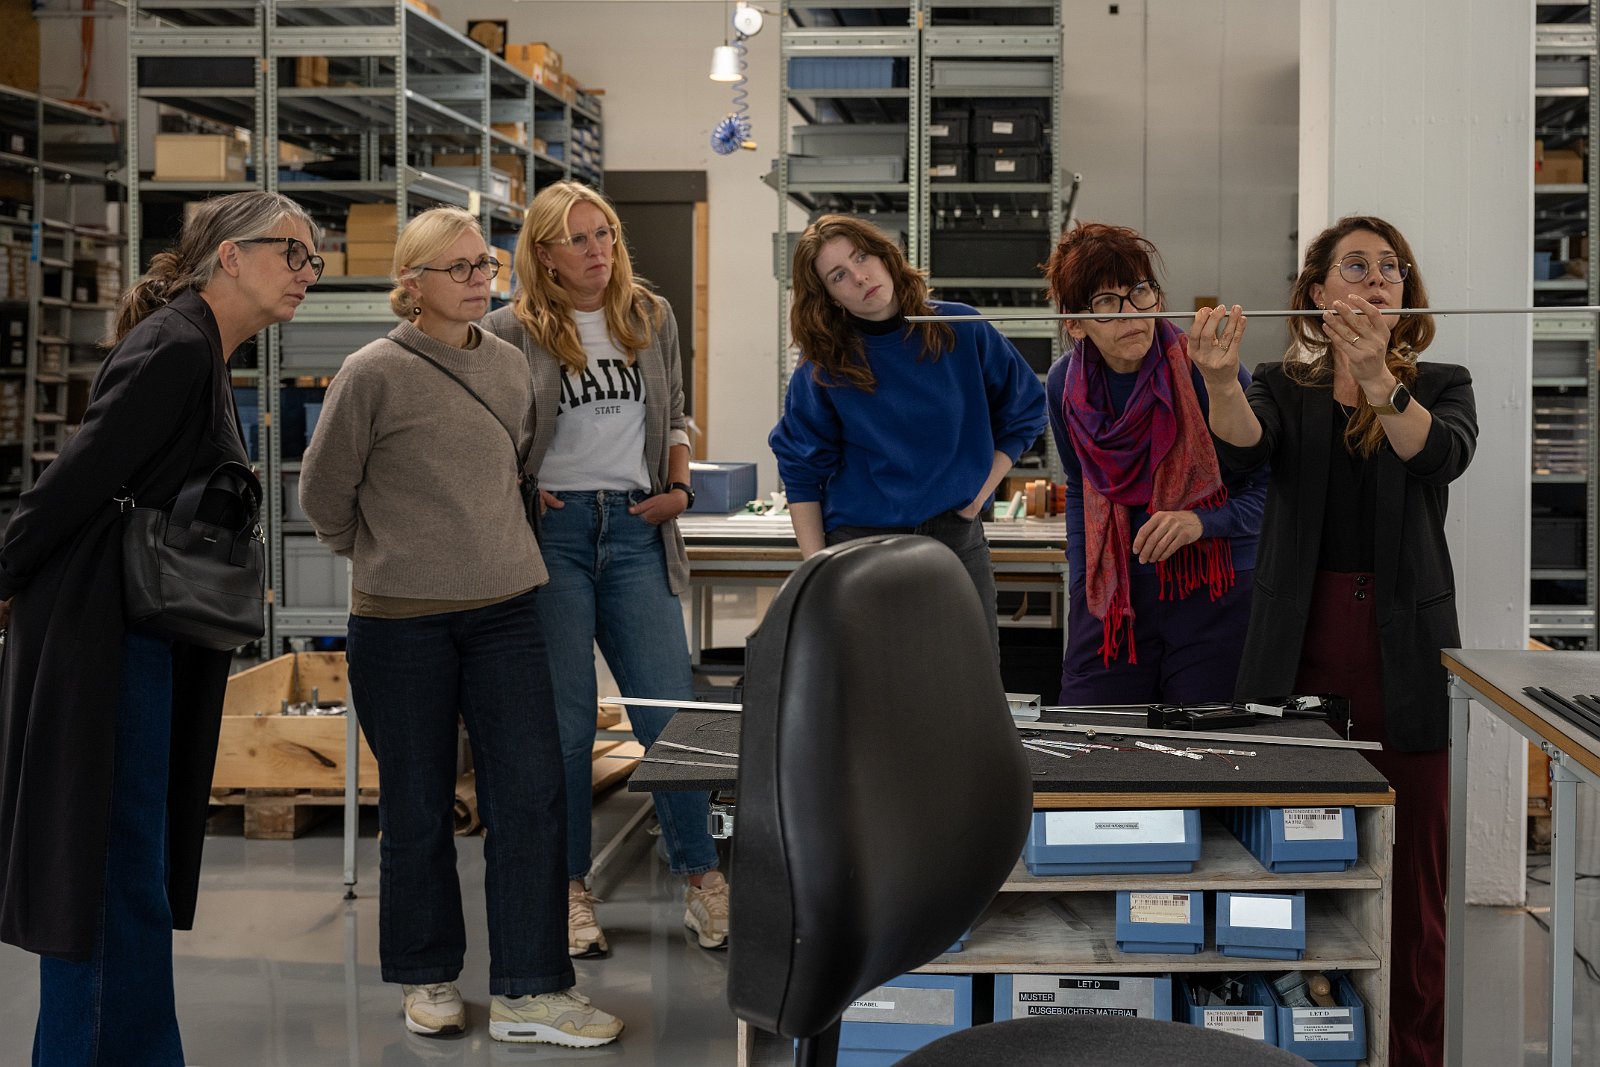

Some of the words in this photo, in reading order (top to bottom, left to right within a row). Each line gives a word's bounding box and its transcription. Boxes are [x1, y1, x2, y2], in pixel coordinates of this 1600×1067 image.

[557, 359, 646, 416] MAIN
[595, 406, 621, 415] STATE
[1077, 980, 1093, 988] LET
[1095, 981, 1101, 989] D
[1020, 993, 1054, 1001] MUSTER
[1029, 1006, 1095, 1016] AUSGEBUCHTES
[1096, 1008, 1135, 1017] MATERIAL
